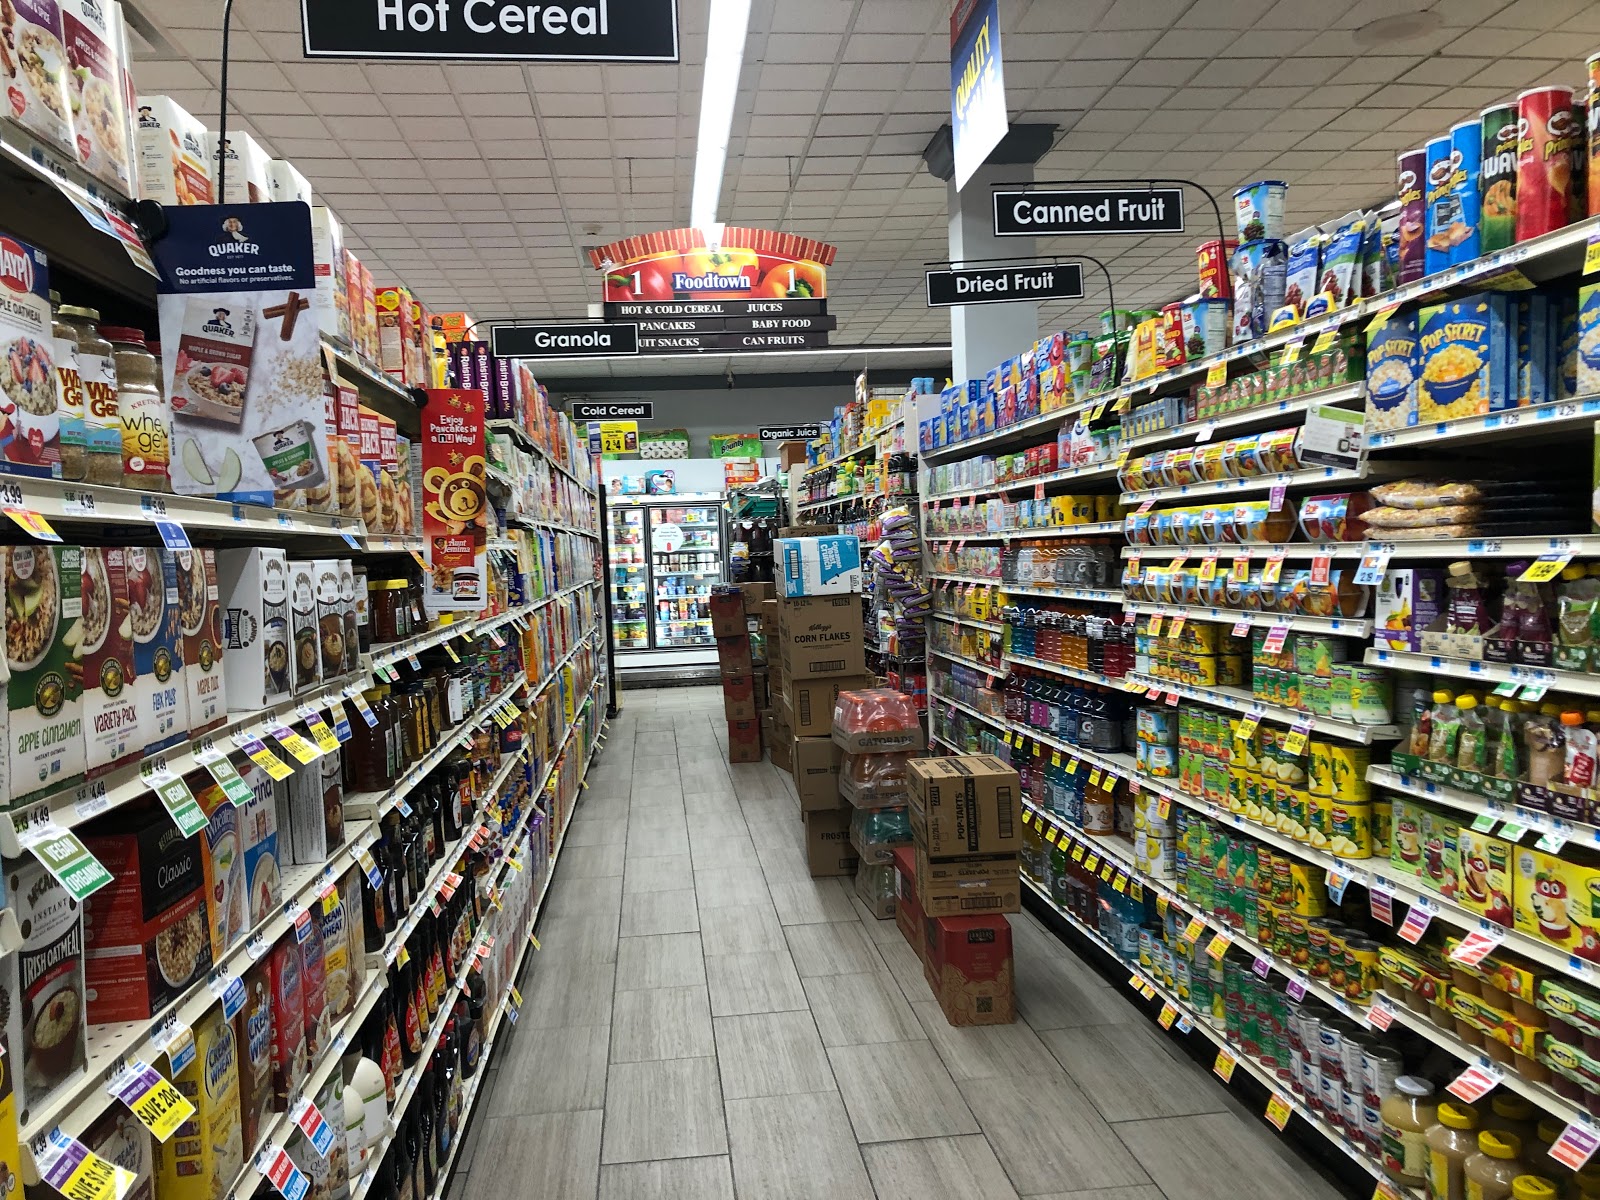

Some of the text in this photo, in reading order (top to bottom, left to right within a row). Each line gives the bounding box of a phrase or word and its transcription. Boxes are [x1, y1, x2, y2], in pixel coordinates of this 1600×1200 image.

[378, 0, 608, 35] Hot Cereal
[955, 15, 990, 120] QUALITY
[1013, 197, 1165, 225] Canned Fruit
[208, 242, 260, 257] QUAKER
[175, 267, 226, 276] Goodness
[228, 266, 246, 276] you
[268, 264, 296, 273] taste.
[190, 276, 217, 284] artificial
[632, 269, 798, 295] 1 Foodtown 1
[956, 271, 1055, 294] Dried Fruit
[13, 301, 42, 324] OATMEAL
[621, 304, 724, 315] HOT & COLD CEREAL
[747, 303, 783, 313] JUICES
[202, 324, 235, 338] QUAKER
[640, 321, 696, 331] PANCAKES
[752, 319, 811, 329] BABY FOOD
[534, 330, 611, 349] Granola
[638, 337, 700, 347] UIT SNACKS
[743, 335, 805, 346] CAN FRUITS
[1420, 322, 1487, 354] POP-SECRET
[85, 381, 119, 402] Whe
[91, 400, 119, 418] Ger
[581, 405, 645, 416] Cold Cereal
[120, 412, 162, 434] whe
[430, 423, 469, 433] Pancakes
[440, 415, 464, 426] Enjoy
[455, 434, 476, 445] Way!
[762, 427, 818, 439] Organic Juice
[721, 439, 744, 455] Bounty
[440, 538, 471, 554] Aunt Jemima
[831, 540, 843, 569] Cinnamon
[820, 543, 832, 571] Crunch
[808, 623, 832, 632] Kellogg's
[794, 631, 851, 644] CORN FLAKES
[858, 735, 915, 747] GATORADE
[955, 791, 965, 840] POP-TARTS
[820, 831, 850, 841] FROSTE
[43, 838, 79, 862] VEGAN
[65, 862, 106, 893] ORGANIC
[157, 854, 192, 890] Classic
[33, 897, 68, 924] INSTANT
[23, 953, 47, 989] IRISH
[46, 927, 80, 966] OATMEAL
[248, 1006, 269, 1040] CREA
[136, 1095, 166, 1127] SAVE
[157, 1086, 182, 1111] 20¢
[69, 1176, 102, 1200] SAVE
